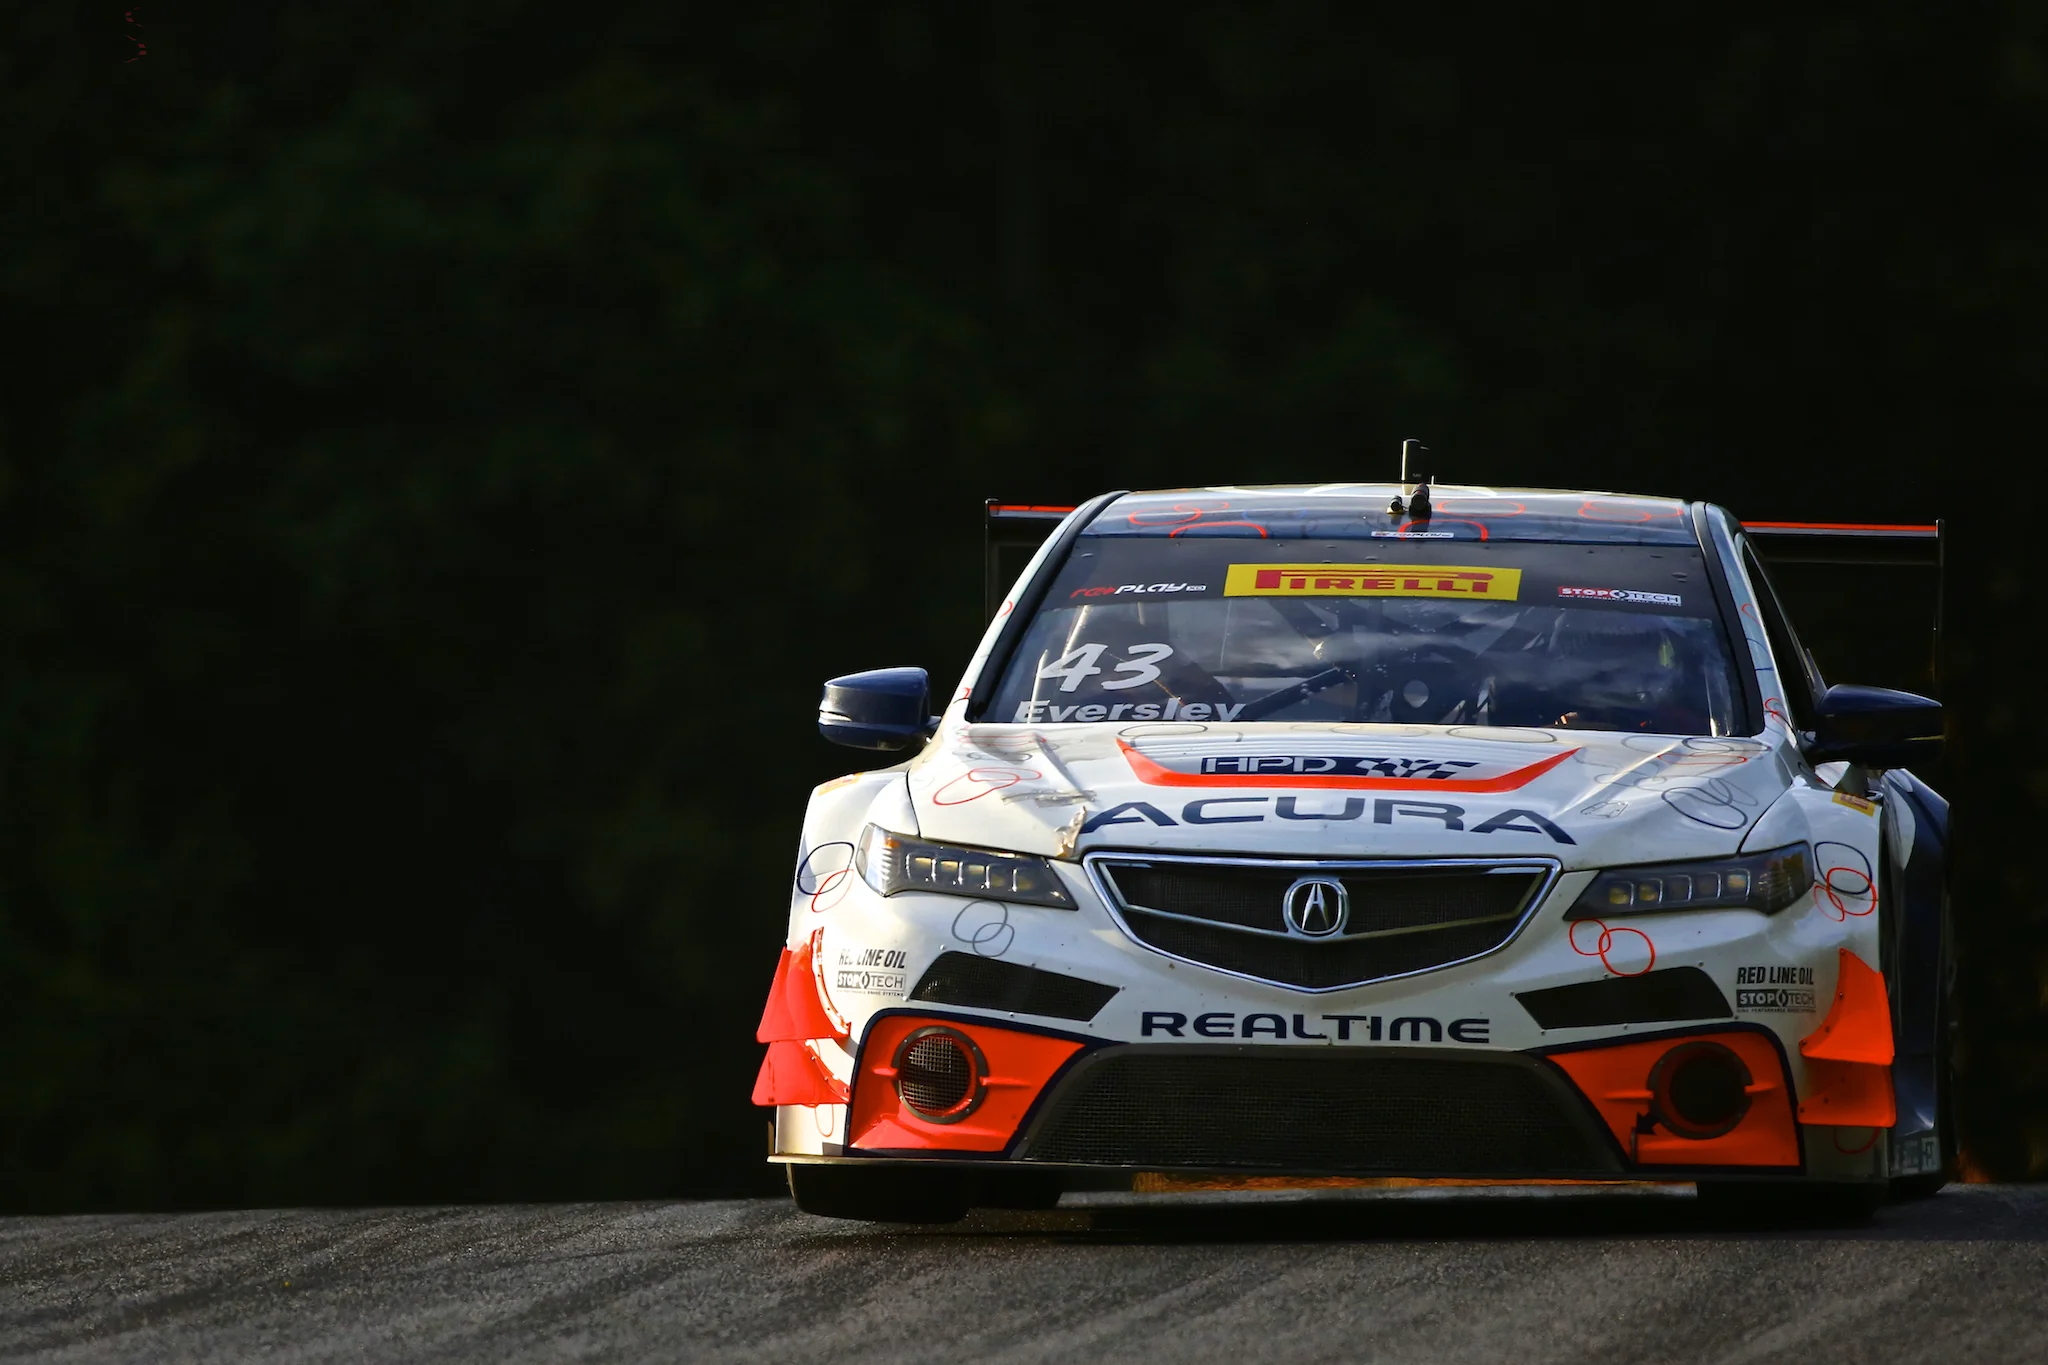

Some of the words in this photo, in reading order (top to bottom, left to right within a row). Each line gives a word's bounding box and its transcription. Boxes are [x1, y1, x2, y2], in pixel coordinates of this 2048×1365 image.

[1255, 569, 1494, 592] PIRELLI
[1039, 642, 1174, 693] 43
[1012, 697, 1246, 722] Eversley
[1205, 756, 1337, 773] HPD
[1080, 796, 1577, 846] ACURA
[838, 948, 855, 966] RE
[856, 948, 885, 967] LINE
[883, 950, 907, 969] OIL
[1736, 966, 1767, 985] RED
[1768, 966, 1797, 984] LINE
[1798, 967, 1815, 985] OIL
[1140, 1011, 1490, 1044] REALTIME
